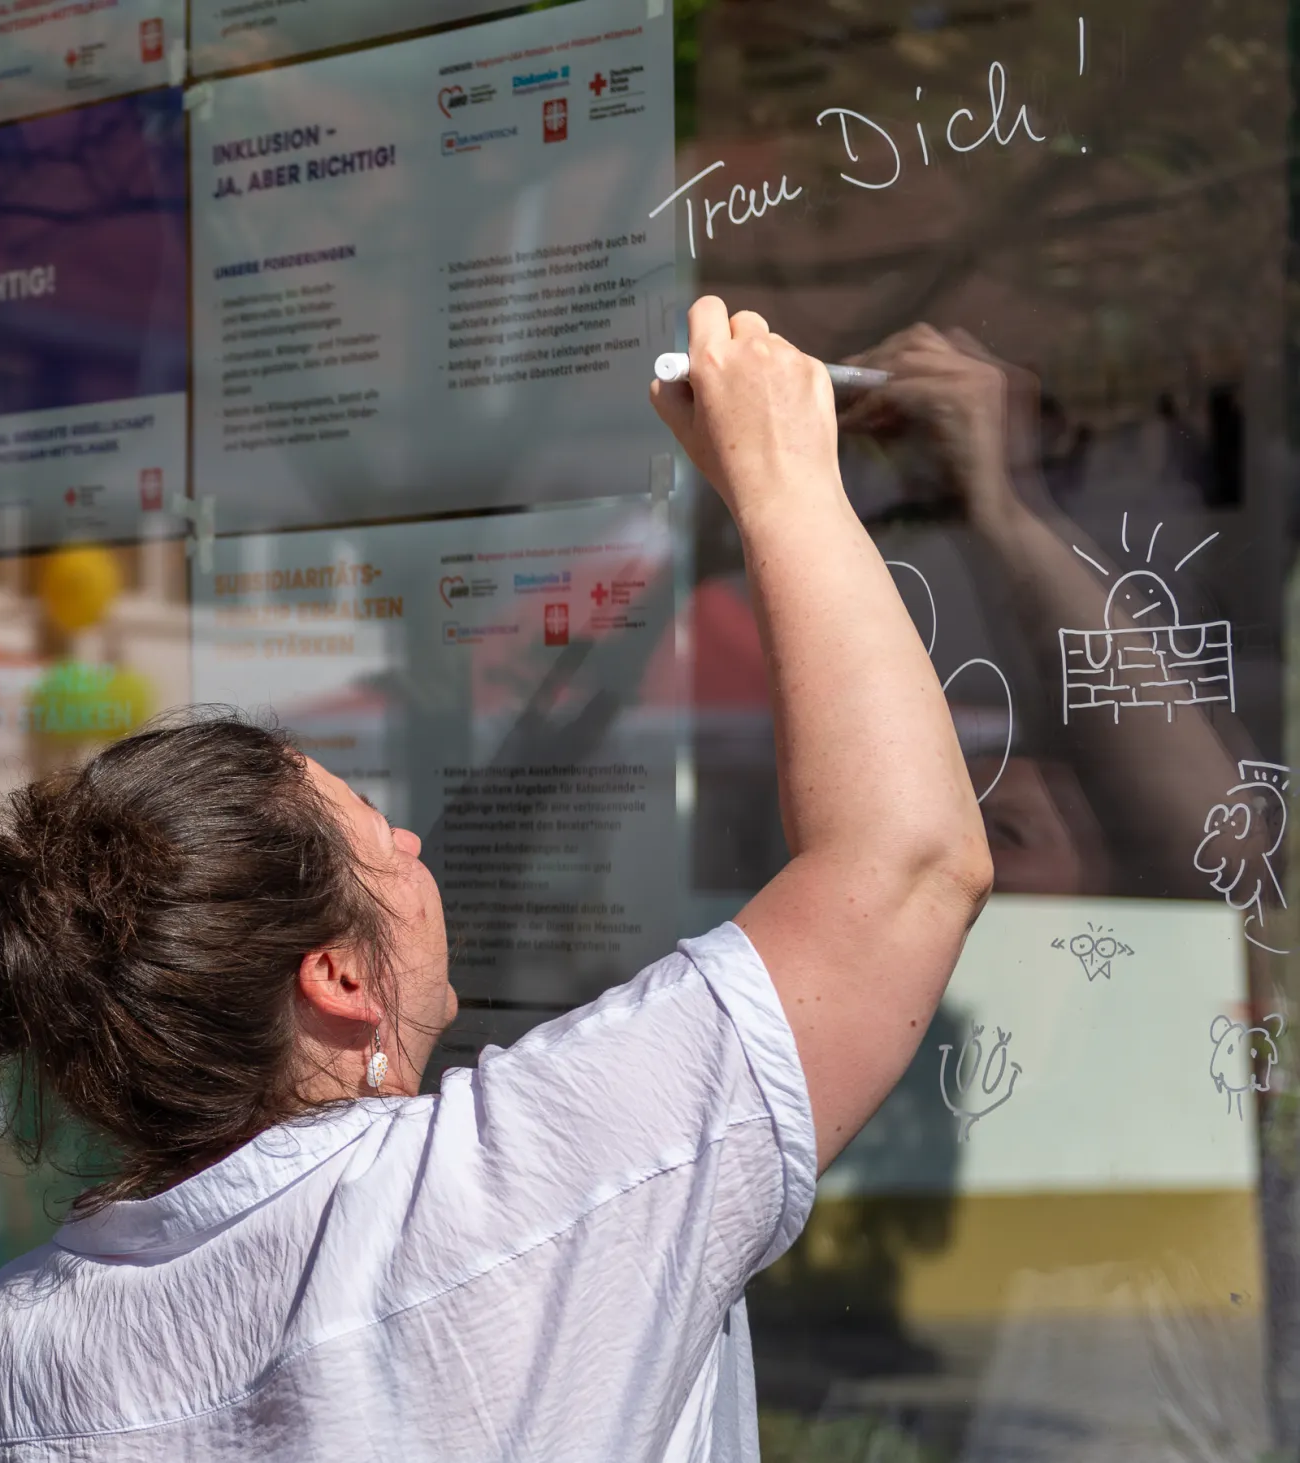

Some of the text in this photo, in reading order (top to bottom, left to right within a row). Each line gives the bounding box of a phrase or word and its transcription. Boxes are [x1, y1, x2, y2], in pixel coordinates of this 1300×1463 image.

[212, 124, 320, 166] INKLUSION
[212, 144, 396, 199] JA, ABER RICHTIG!
[605, 235, 628, 249] auch
[630, 232, 646, 245] bei
[213, 244, 357, 280] UNSERE FORDERUNGEN
[548, 256, 608, 276] Förderbedarf
[577, 281, 591, 294] als
[593, 277, 616, 291] erste
[570, 297, 616, 314] Menschen
[618, 294, 636, 307] mit
[550, 339, 601, 360] Leistungen
[603, 334, 640, 350] müssen
[574, 358, 610, 374] werden
[297, 596, 403, 622] ERHALTEN
[263, 633, 355, 659] STÄRKEN
[558, 783, 573, 794] für
[580, 903, 607, 915] durch
[609, 903, 625, 915] die
